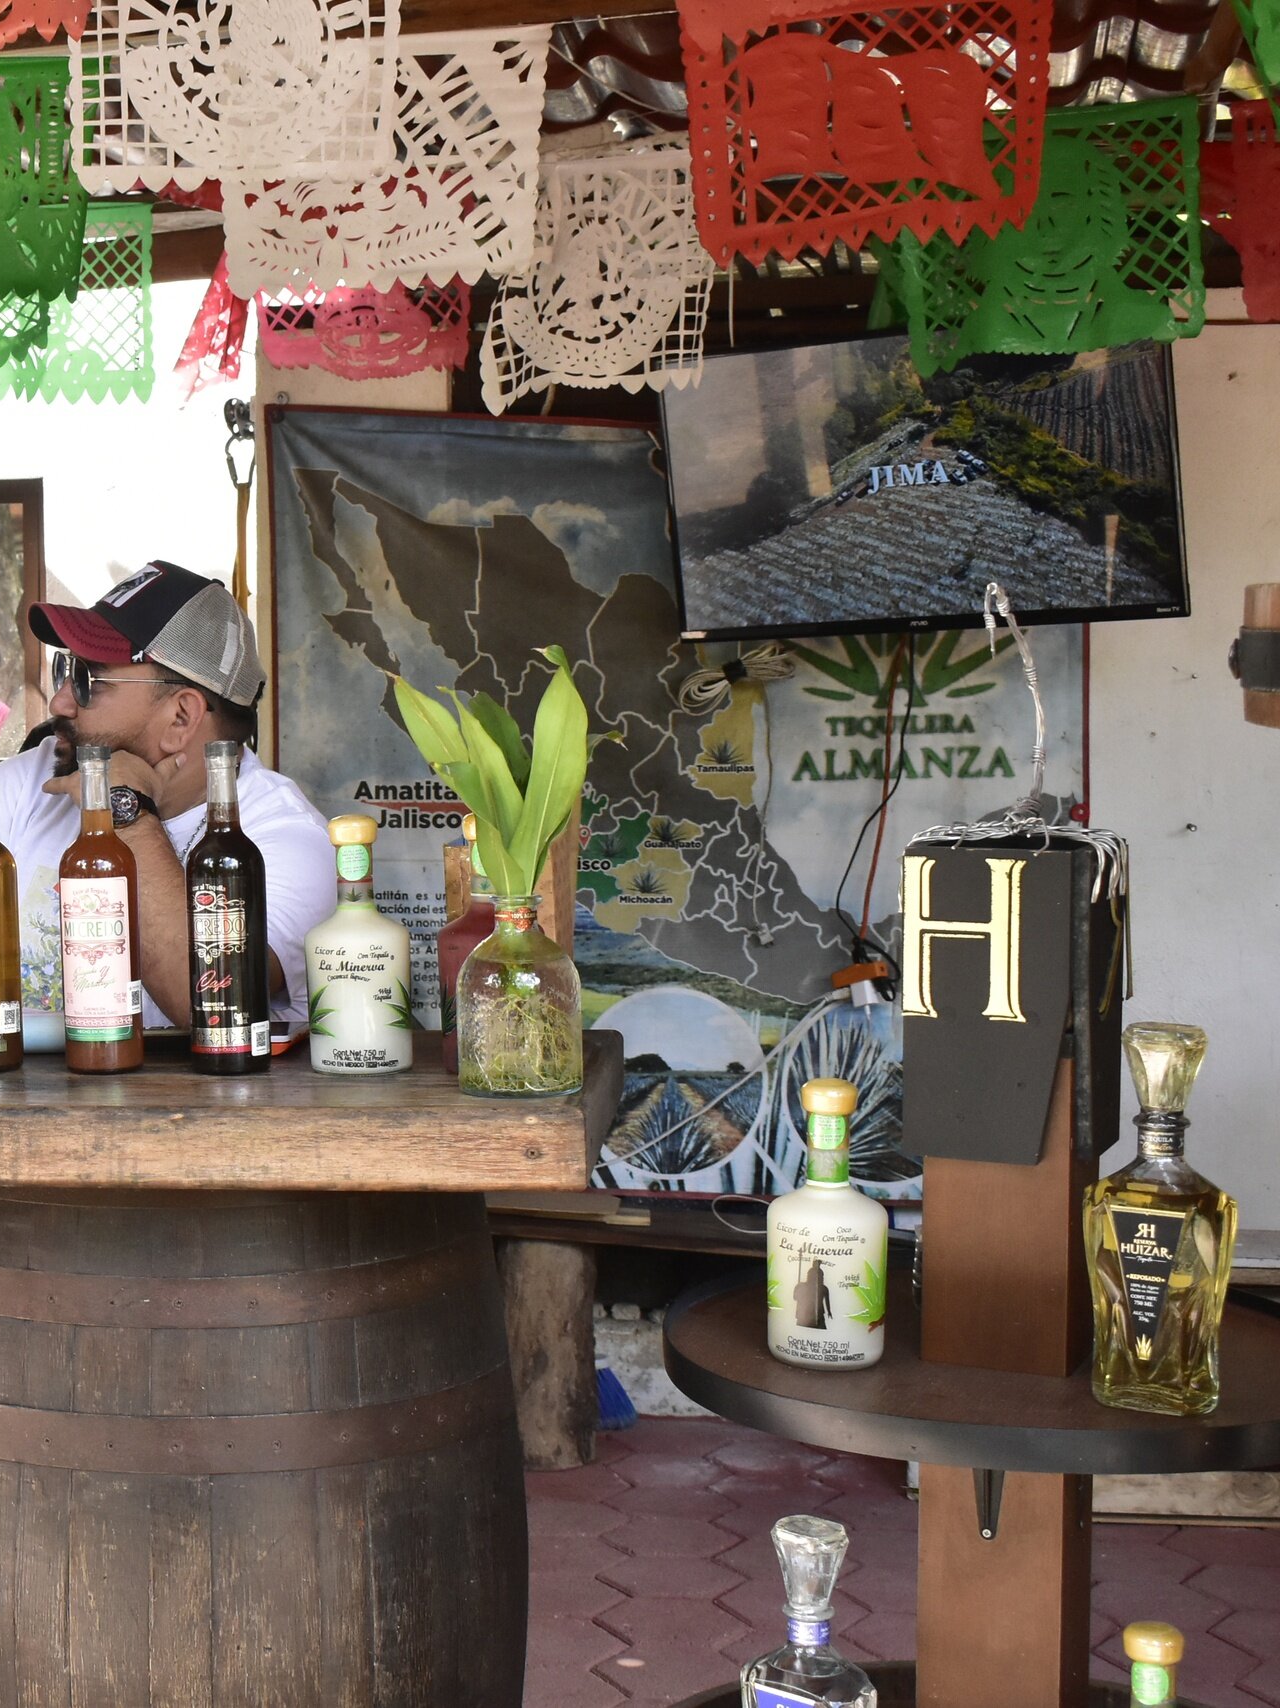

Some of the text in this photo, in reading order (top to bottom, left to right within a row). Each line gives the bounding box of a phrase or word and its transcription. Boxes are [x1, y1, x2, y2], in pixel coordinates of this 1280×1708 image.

[867, 461, 950, 494] JIMA
[825, 714, 975, 739] TEQUILERA
[697, 764, 755, 774] Tamaulipas
[792, 746, 1015, 781] ALMANZA
[377, 809, 462, 829] Jalisco
[644, 840, 702, 850] Guanajuato
[577, 858, 611, 871] isco
[375, 890, 409, 900] atitán
[619, 895, 673, 904] Michoacán
[377, 903, 410, 914] lación
[413, 904, 430, 914] del
[78, 920, 124, 937] CREDO
[194, 917, 245, 935] CREDO
[401, 918, 447, 928] Su nomb
[315, 946, 346, 955] Licor de
[319, 960, 385, 972] La Minerva
[196, 970, 232, 992] Café
[777, 1222, 810, 1237] Licor de
[822, 1234, 859, 1244] Con Tequila
[1133, 1238, 1157, 1246] RESERVA
[779, 1237, 853, 1256] La Minerva
[1121, 1243, 1173, 1260] HUIZAR
[1129, 1273, 1161, 1283] REPOSADO
[800, 1352, 823, 1360] MEXICO
